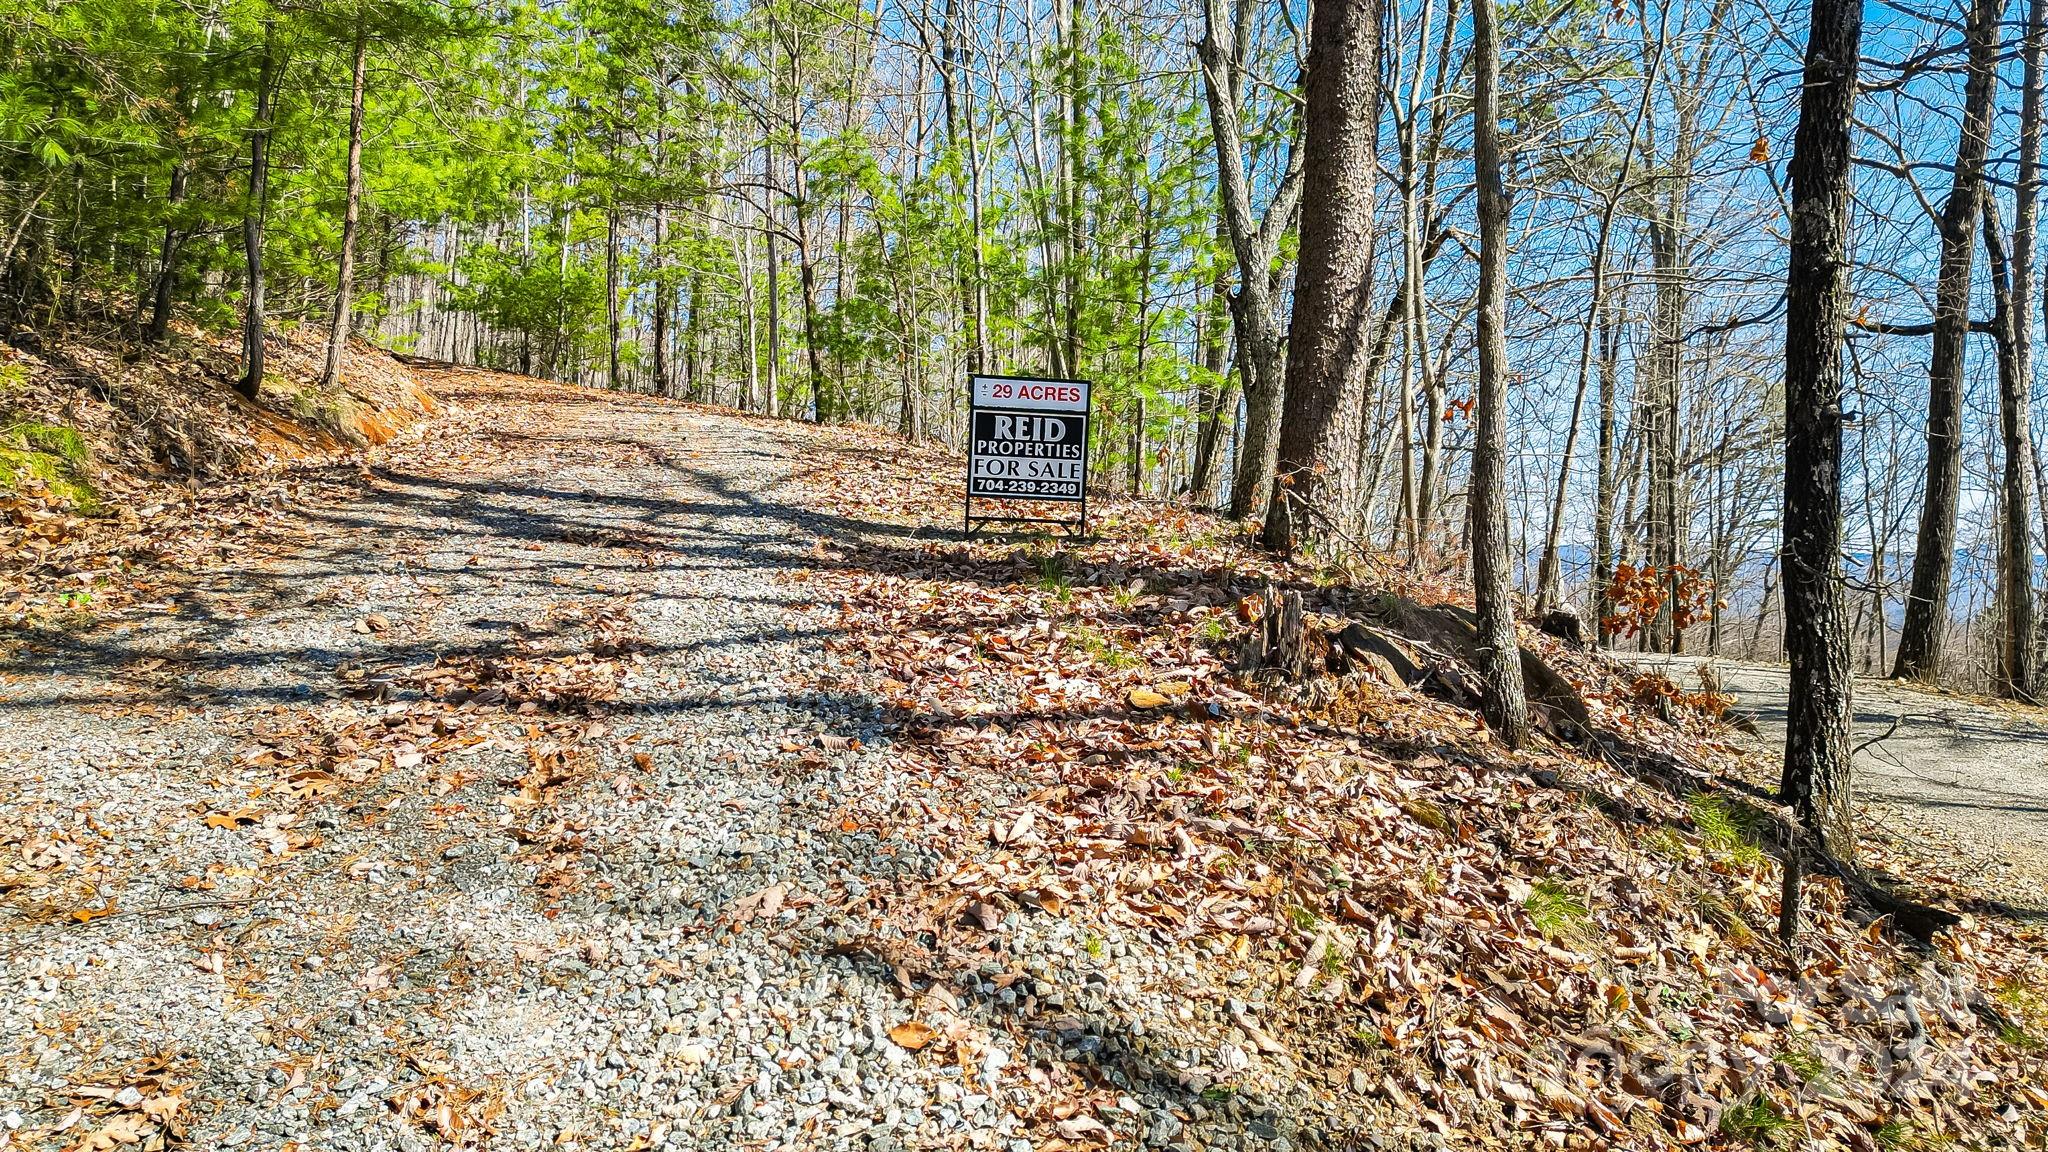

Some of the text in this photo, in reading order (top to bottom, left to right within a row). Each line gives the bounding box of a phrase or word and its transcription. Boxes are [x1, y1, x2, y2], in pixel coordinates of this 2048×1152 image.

[992, 384, 1012, 398] 29
[1018, 386, 1080, 402] ACRES
[994, 415, 1066, 442] REID
[977, 440, 1080, 458] PROPERTIES
[975, 459, 1080, 479] FOR SALE
[978, 479, 1076, 494] 704-239-2349
